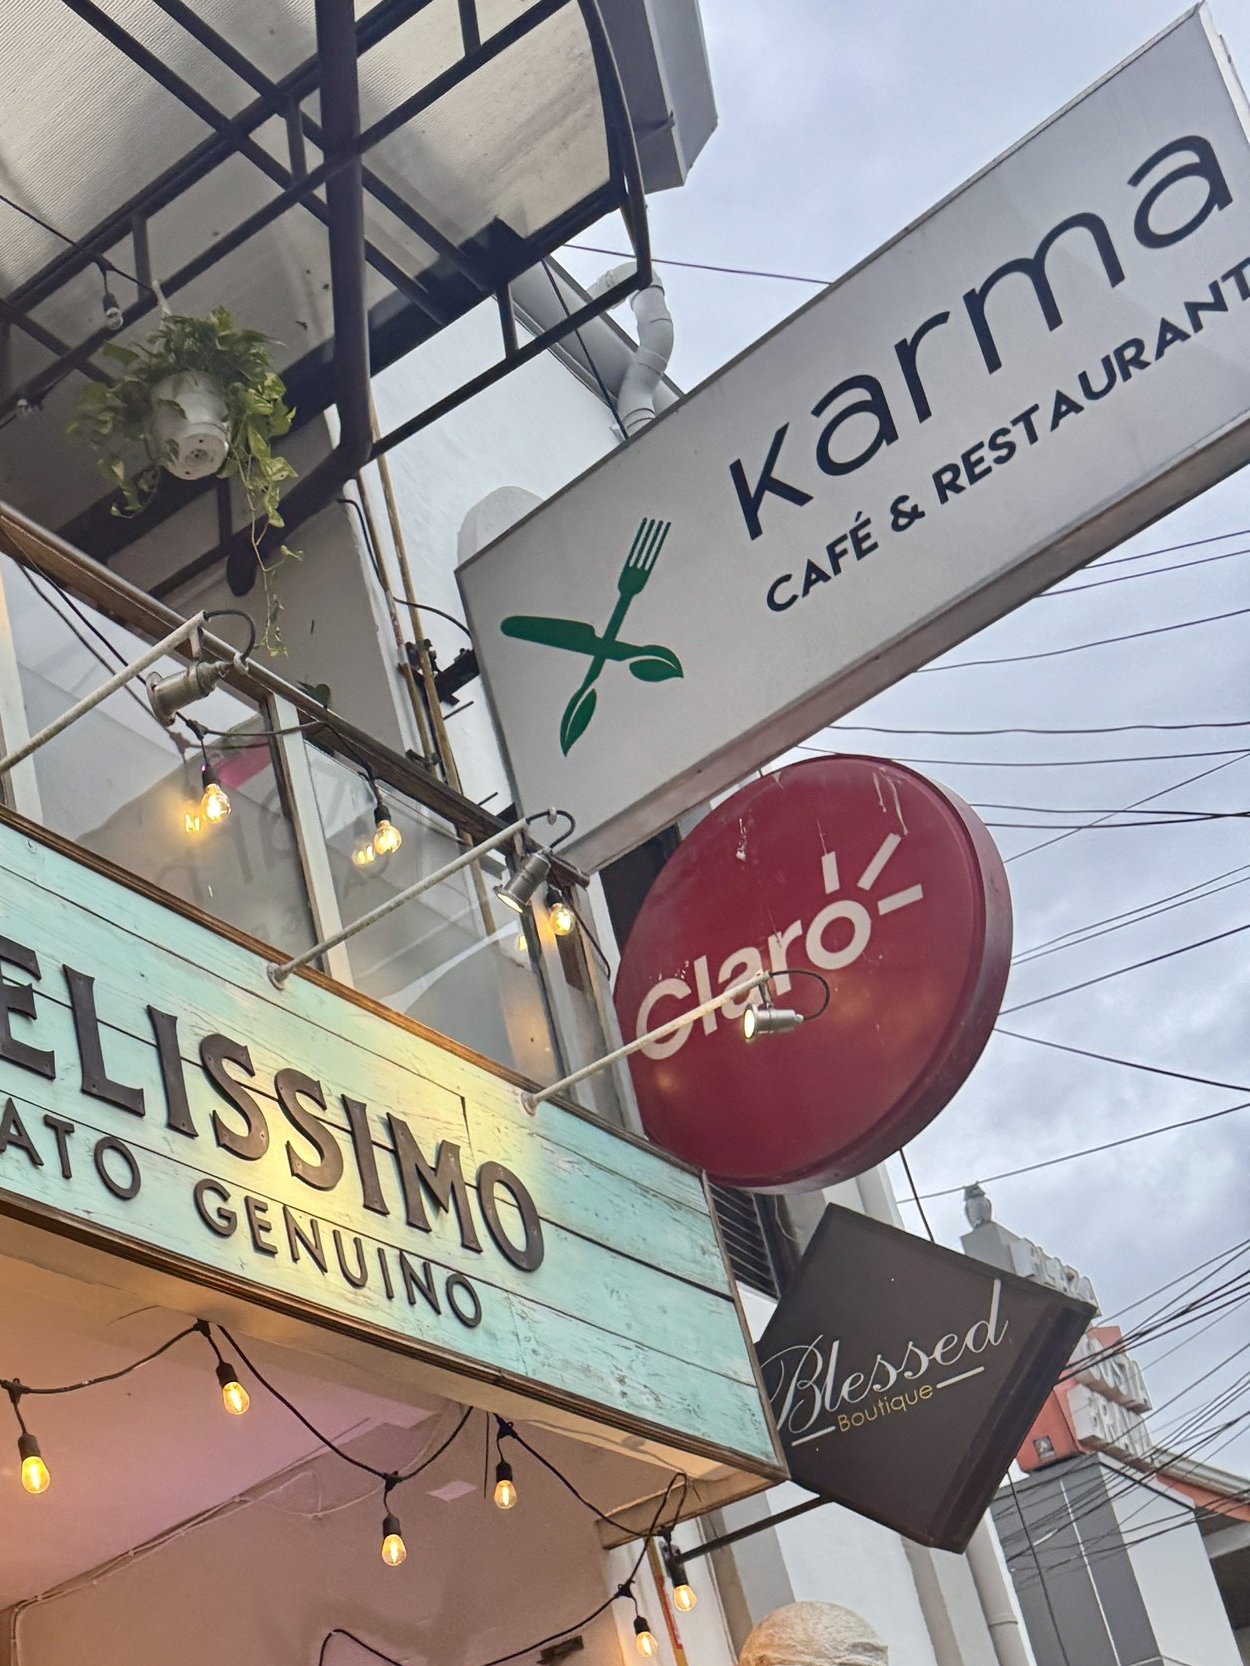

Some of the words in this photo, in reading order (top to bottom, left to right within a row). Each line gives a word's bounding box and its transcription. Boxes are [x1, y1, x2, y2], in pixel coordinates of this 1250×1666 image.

[729, 134, 1234, 541] karma
[765, 511, 879, 613] CAFÉ
[890, 494, 926, 533] &
[931, 256, 1250, 506] RESTAURANT
[635, 899, 872, 1061] Claro
[192, 1177, 482, 1328] GENUINO
[760, 1278, 1009, 1435] Blessed
[836, 1380, 934, 1433] Boutique
